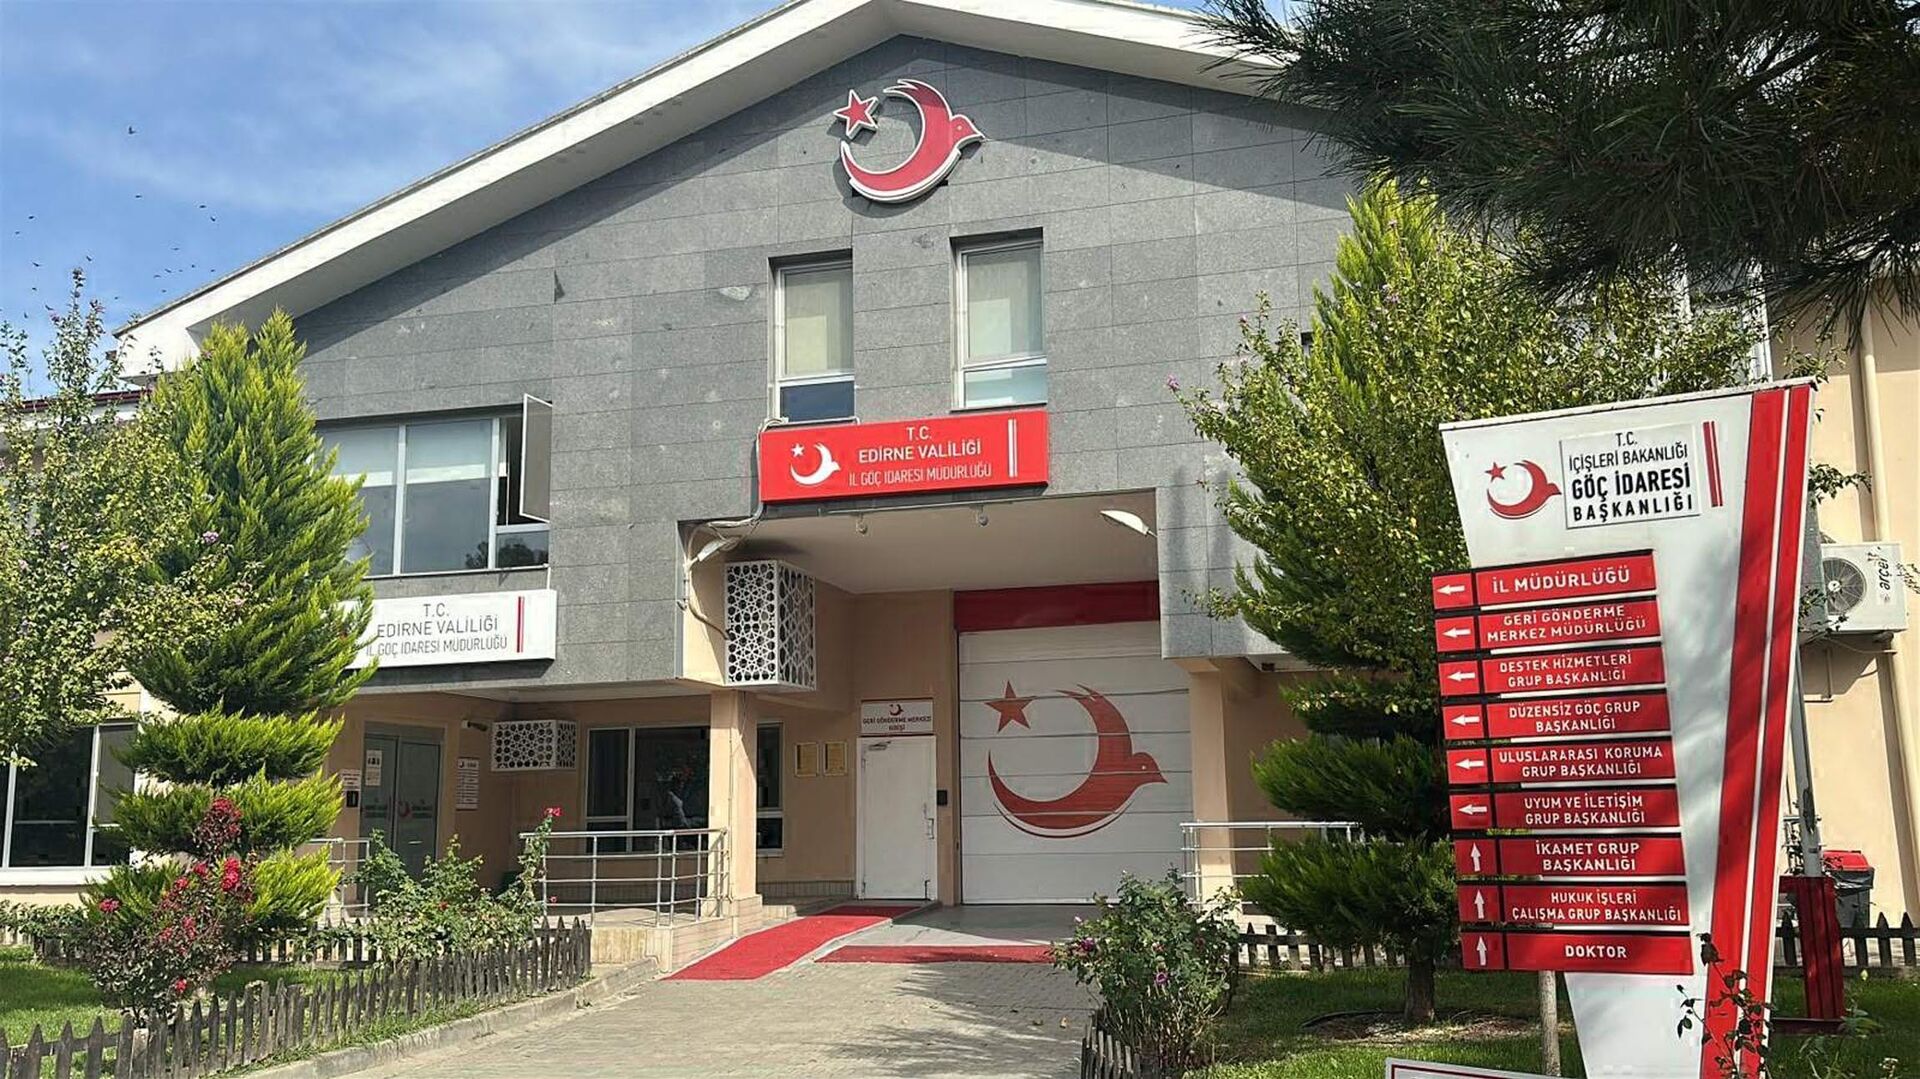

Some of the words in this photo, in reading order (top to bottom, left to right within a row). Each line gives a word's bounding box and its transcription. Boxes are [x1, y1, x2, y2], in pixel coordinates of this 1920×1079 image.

[906, 426, 932, 441] T.C.
[1616, 431, 1638, 447] T.C.
[859, 445, 914, 464] EDİRNE
[917, 439, 981, 458] VALİLİĞİ
[1568, 450, 1619, 474] İÇİŞLERİ
[1622, 441, 1688, 465] BAKANLIĞI
[1572, 473, 1608, 502] GÖÇ
[1615, 462, 1690, 496] İDARESİ
[1573, 491, 1692, 522] BAŞKANLIĞI
[1492, 576, 1509, 594] İL
[1514, 564, 1630, 592] MÜDÜRLÜĞÜ
[423, 603, 450, 618] T.C.
[1503, 610, 1537, 626] GERİ
[1542, 605, 1625, 623] GÖNDERME
[377, 620, 432, 639] EDİRNE
[436, 615, 499, 635] VALİLİĞİ
[1487, 628, 1547, 642] MERKEZ
[1551, 615, 1646, 638] MÜDÜRLÜĞÜ
[1500, 659, 1549, 673] DESTEK
[1553, 650, 1632, 669] HİZMETLERİ
[1508, 676, 1542, 687] GRUP
[1546, 667, 1626, 685] BAŞKANLIĞI
[1509, 702, 1572, 718] DÜZENSİZ
[1575, 700, 1601, 716] GÖÇ
[1604, 701, 1641, 713] GRUP
[1536, 715, 1615, 733] BAŞKANLIĞI
[1499, 749, 1598, 763] ULUSLARARASI
[1604, 746, 1663, 759] KORUMA
[1522, 766, 1556, 777] GRUP
[1560, 760, 1641, 777] BAŞKANLIĞI
[1524, 797, 1561, 809] UYUM
[1564, 797, 1581, 808] VE
[1584, 792, 1643, 809] İLETİŞİM
[1526, 813, 1560, 825] GRUP
[1564, 808, 1645, 825] BAŞKANLIĞI
[1536, 840, 1594, 855] İKAMET
[1597, 843, 1640, 855] GRUP
[1543, 856, 1635, 872] BAŞKANLIĞI
[1551, 892, 1594, 904] HUKUK
[1596, 889, 1637, 906] İŞLERİ
[1512, 907, 1566, 921] ÇALIŞMA
[1568, 909, 1601, 920] GRUP
[1604, 906, 1681, 922] BAŞKANLIĞI
[1565, 945, 1627, 958] DOKTOR
